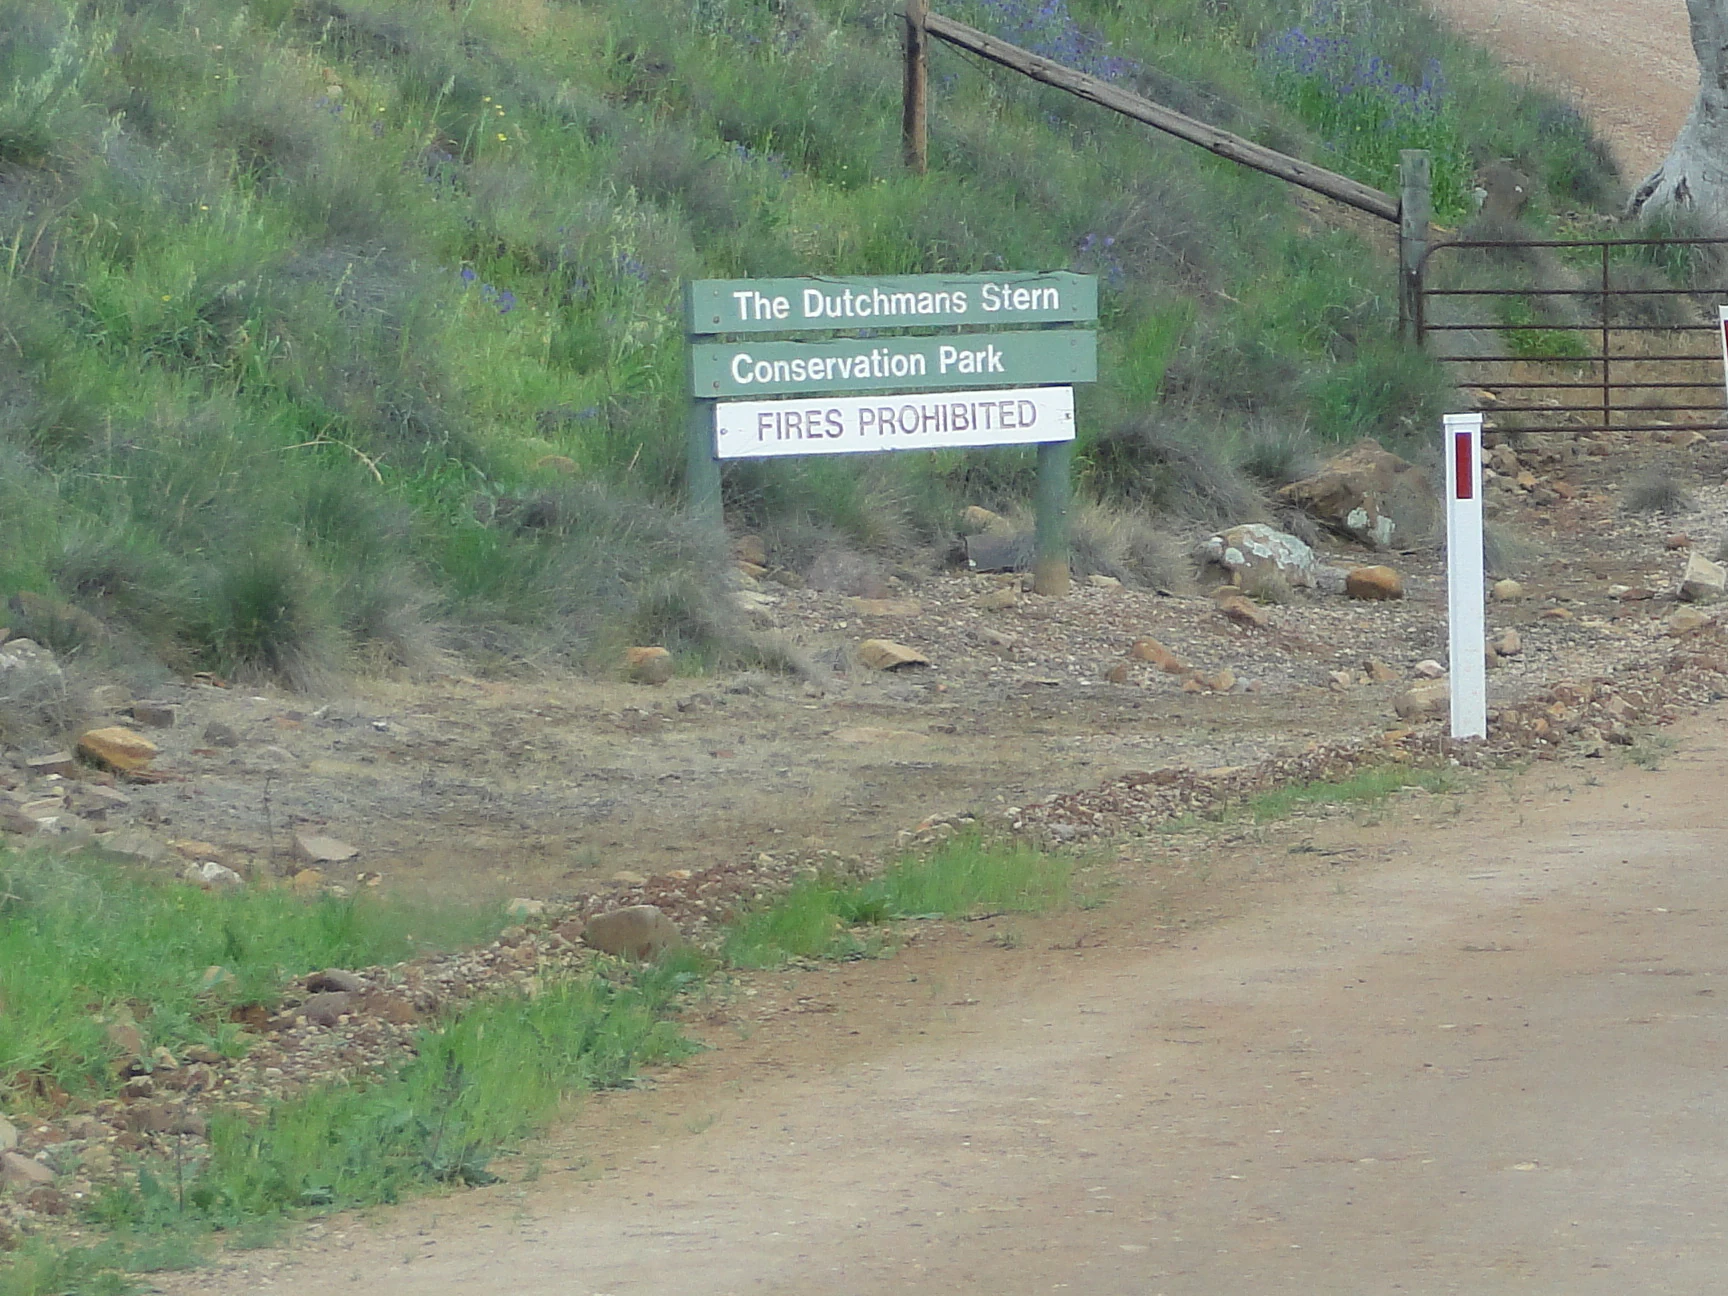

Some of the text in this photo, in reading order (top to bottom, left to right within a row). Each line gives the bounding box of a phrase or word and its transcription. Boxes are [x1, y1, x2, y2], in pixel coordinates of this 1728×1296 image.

[733, 282, 1059, 320] The Dutchmans Stern
[732, 344, 1005, 385] Conservation Park
[757, 399, 1037, 441] FIRES PROHIBITED
